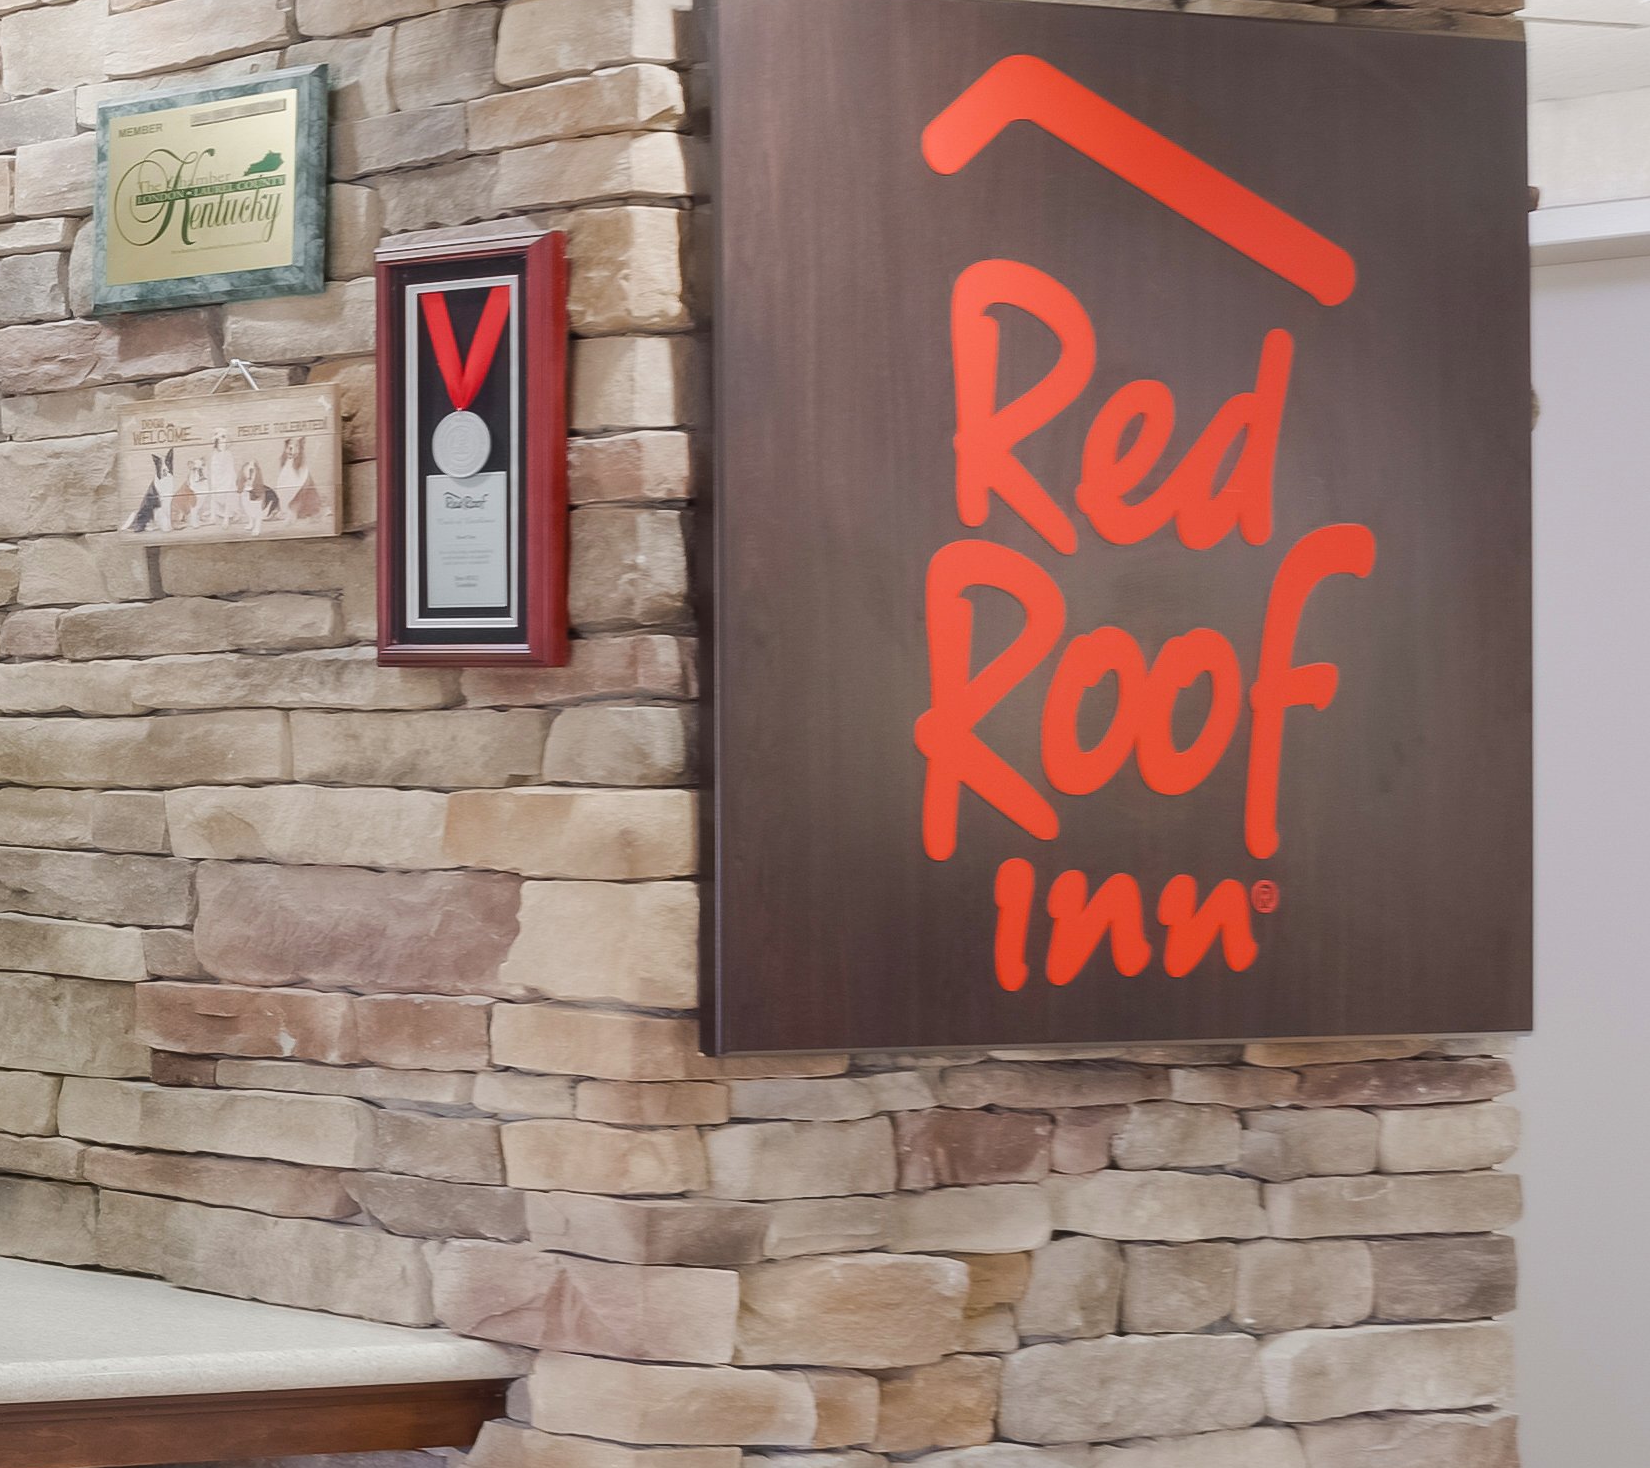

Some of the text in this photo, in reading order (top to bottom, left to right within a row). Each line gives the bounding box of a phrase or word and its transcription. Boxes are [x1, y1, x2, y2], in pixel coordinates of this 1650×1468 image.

[118, 123, 163, 138] MEMBER
[114, 148, 283, 246] Kentucky
[133, 426, 193, 445] WELCOME
[950, 258, 1293, 555] Red
[914, 523, 1376, 862] Roof
